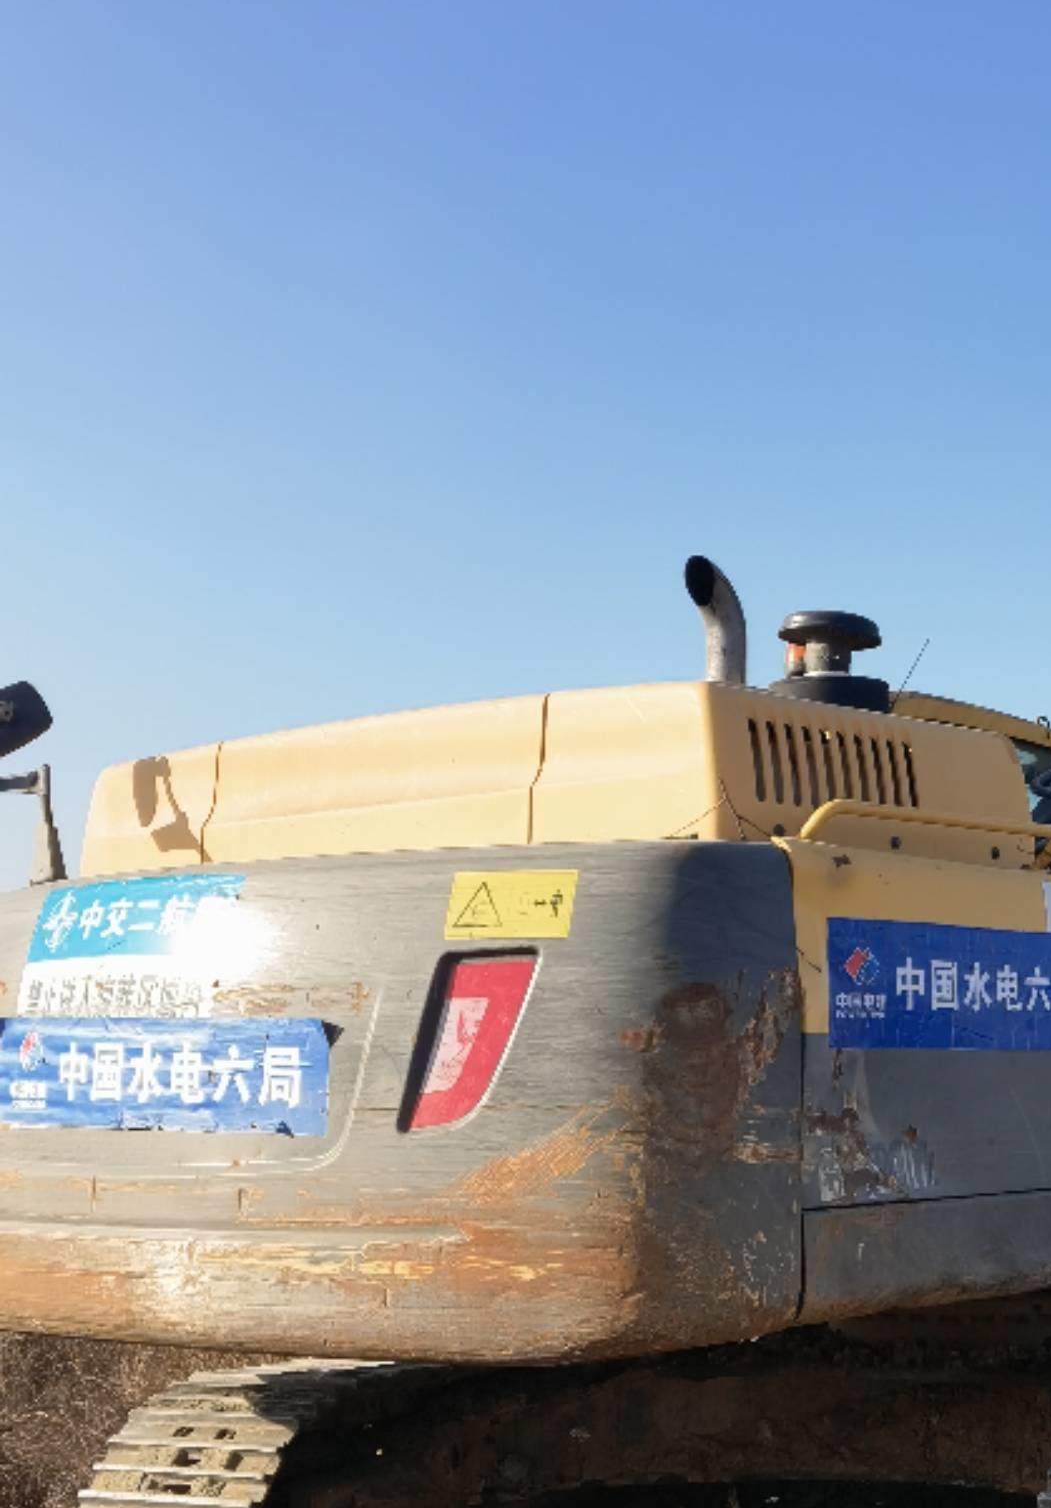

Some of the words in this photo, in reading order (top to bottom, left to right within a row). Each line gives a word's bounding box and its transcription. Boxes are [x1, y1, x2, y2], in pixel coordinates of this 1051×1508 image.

[58, 1042, 303, 1109] 中国水电六局
